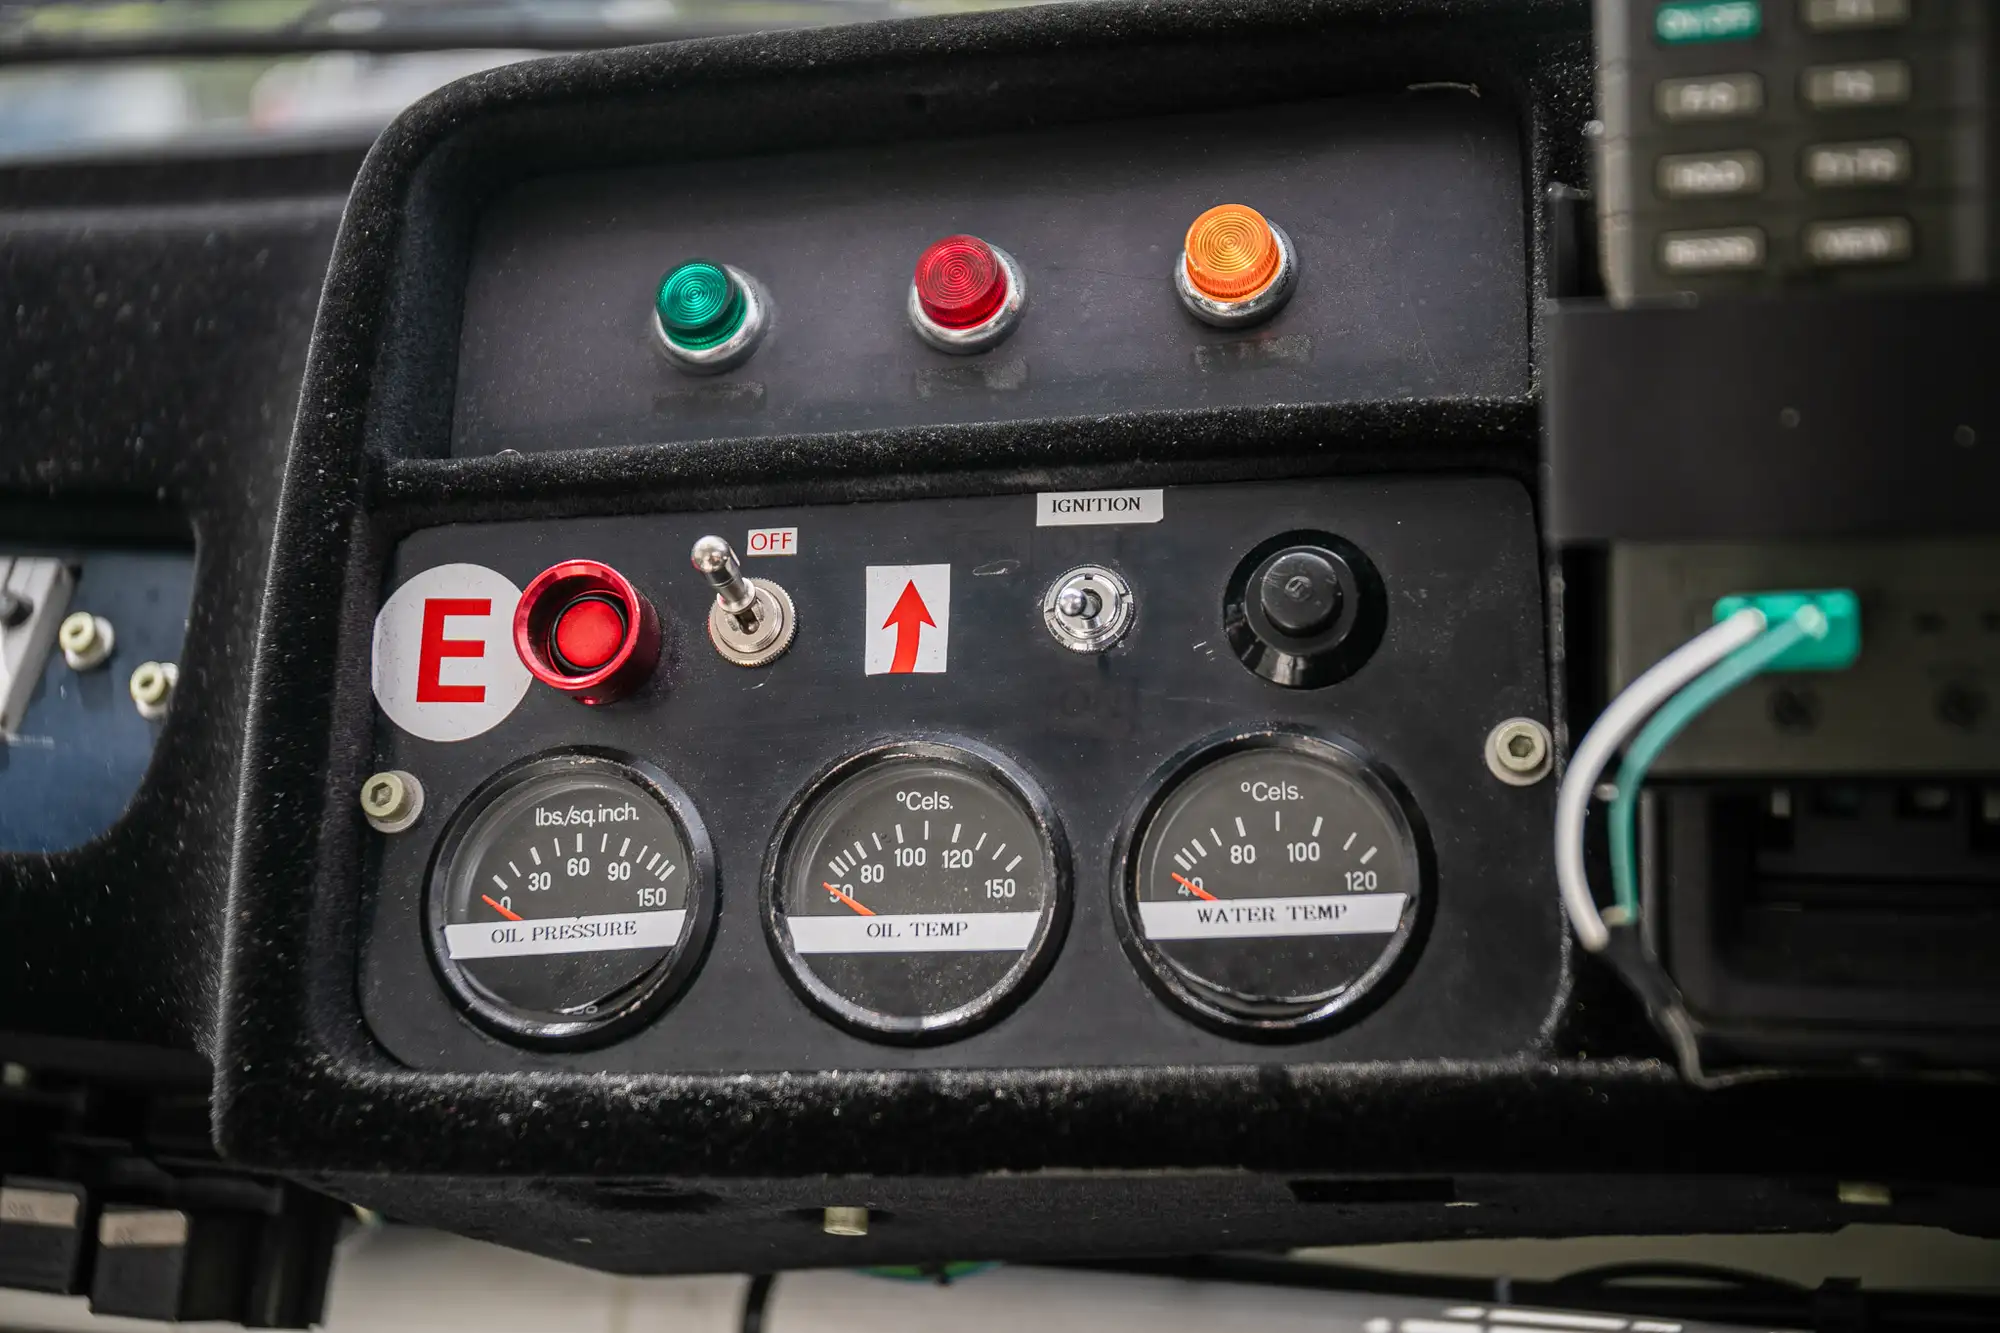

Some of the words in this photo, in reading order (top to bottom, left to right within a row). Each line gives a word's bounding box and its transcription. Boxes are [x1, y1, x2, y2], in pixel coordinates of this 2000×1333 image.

[1051, 496, 1142, 514] IGNITION
[750, 531, 792, 551] OFF
[415, 597, 493, 704] E
[893, 846, 928, 868] 100
[941, 848, 975, 869] 120
[1229, 843, 1257, 864] 80
[1286, 841, 1321, 864] 100
[566, 857, 592, 877] 60
[607, 860, 632, 883] 90
[859, 863, 885, 884] 80
[527, 871, 553, 892] 30
[984, 878, 1017, 899] 150
[1176, 876, 1204, 898] 40
[1344, 870, 1379, 892] 120
[500, 895, 512, 912] 0
[635, 886, 669, 908] 150
[828, 883, 854, 903] 50
[1196, 906, 1276, 924] WATER
[1286, 903, 1348, 921] TEMP
[490, 926, 525, 944] OIL
[531, 920, 638, 942] PRESSURE
[866, 922, 901, 939] OIL
[909, 922, 969, 938] TEMP
